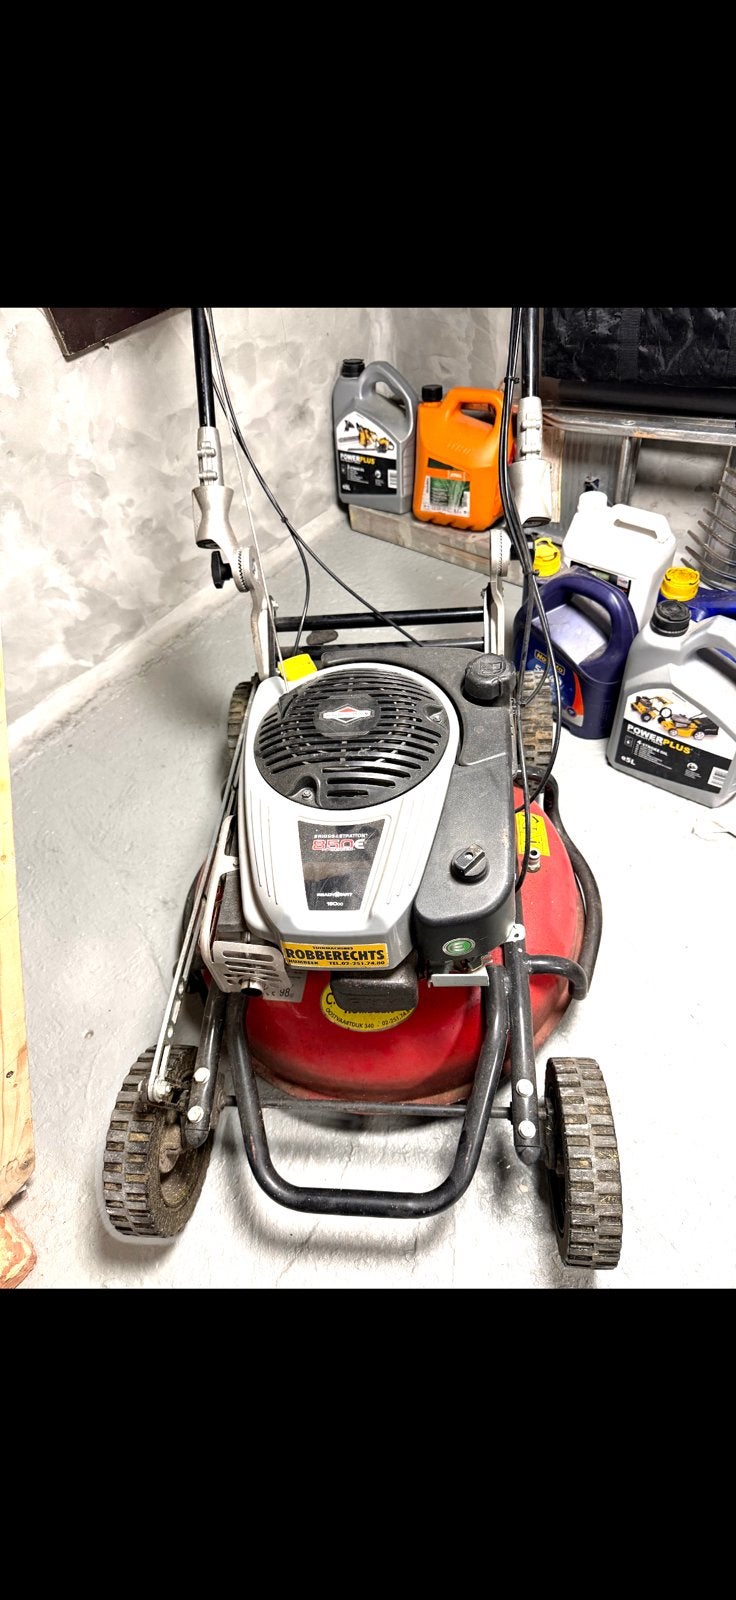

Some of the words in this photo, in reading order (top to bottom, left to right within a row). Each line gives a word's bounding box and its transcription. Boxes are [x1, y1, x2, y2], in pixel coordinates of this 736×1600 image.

[340, 453, 376, 465] POWERPLUS
[627, 724, 692, 755] POWERPLUS
[285, 948, 385, 960] ROBBERECHTS
